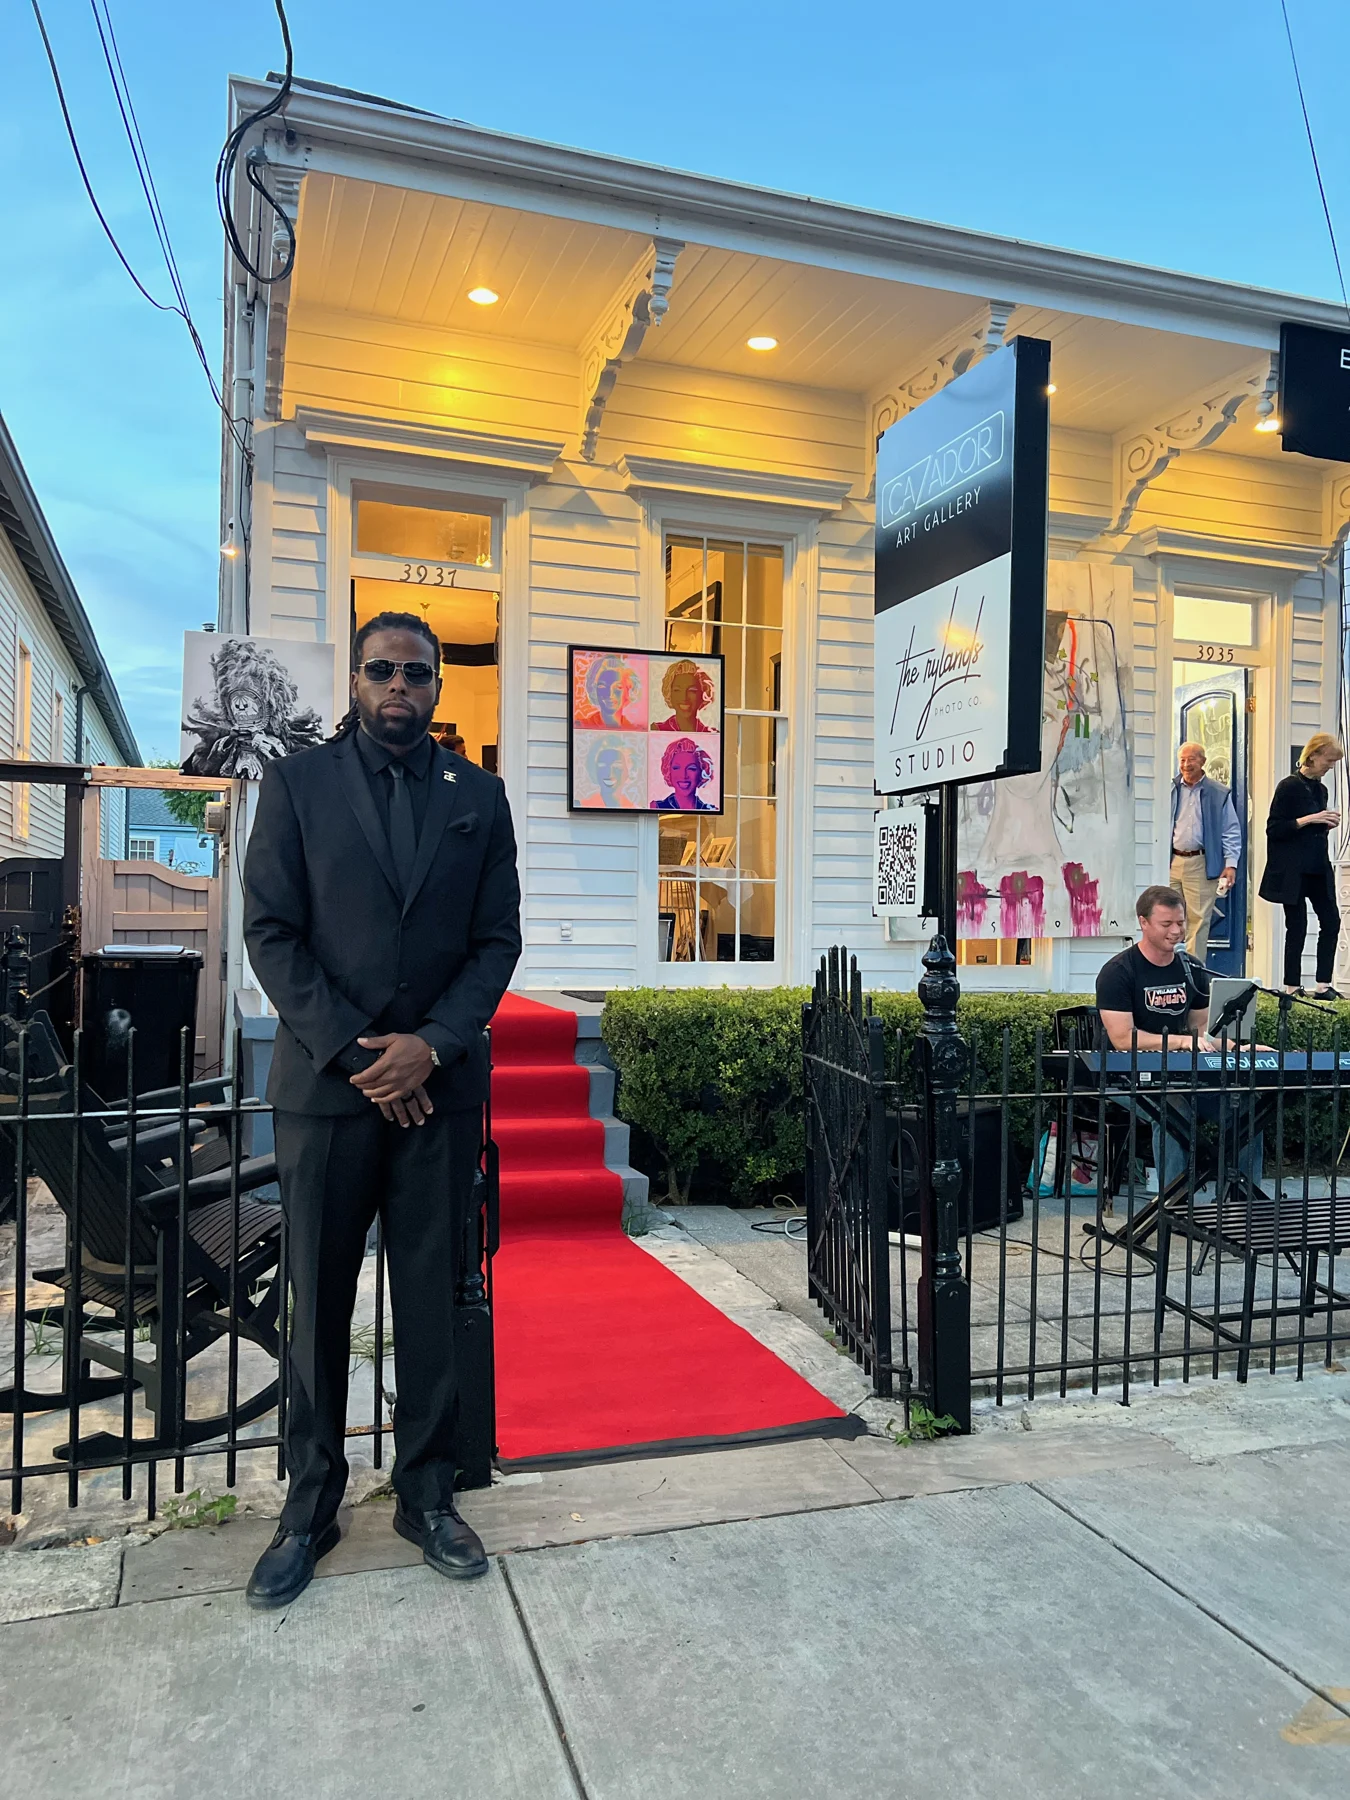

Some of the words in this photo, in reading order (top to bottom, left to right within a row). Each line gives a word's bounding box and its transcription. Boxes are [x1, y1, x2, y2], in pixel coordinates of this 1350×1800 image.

[888, 426, 993, 516] CAZADOR
[896, 521, 918, 548] ART
[924, 486, 982, 532] GALLERY
[400, 563, 458, 588] 3937
[914, 586, 985, 742] rylands
[1196, 644, 1234, 663] 3935
[934, 700, 963, 717] PHOTO
[967, 695, 983, 708] CO.
[895, 740, 975, 778] STUDIO
[1147, 987, 1187, 1007] Vanguard
